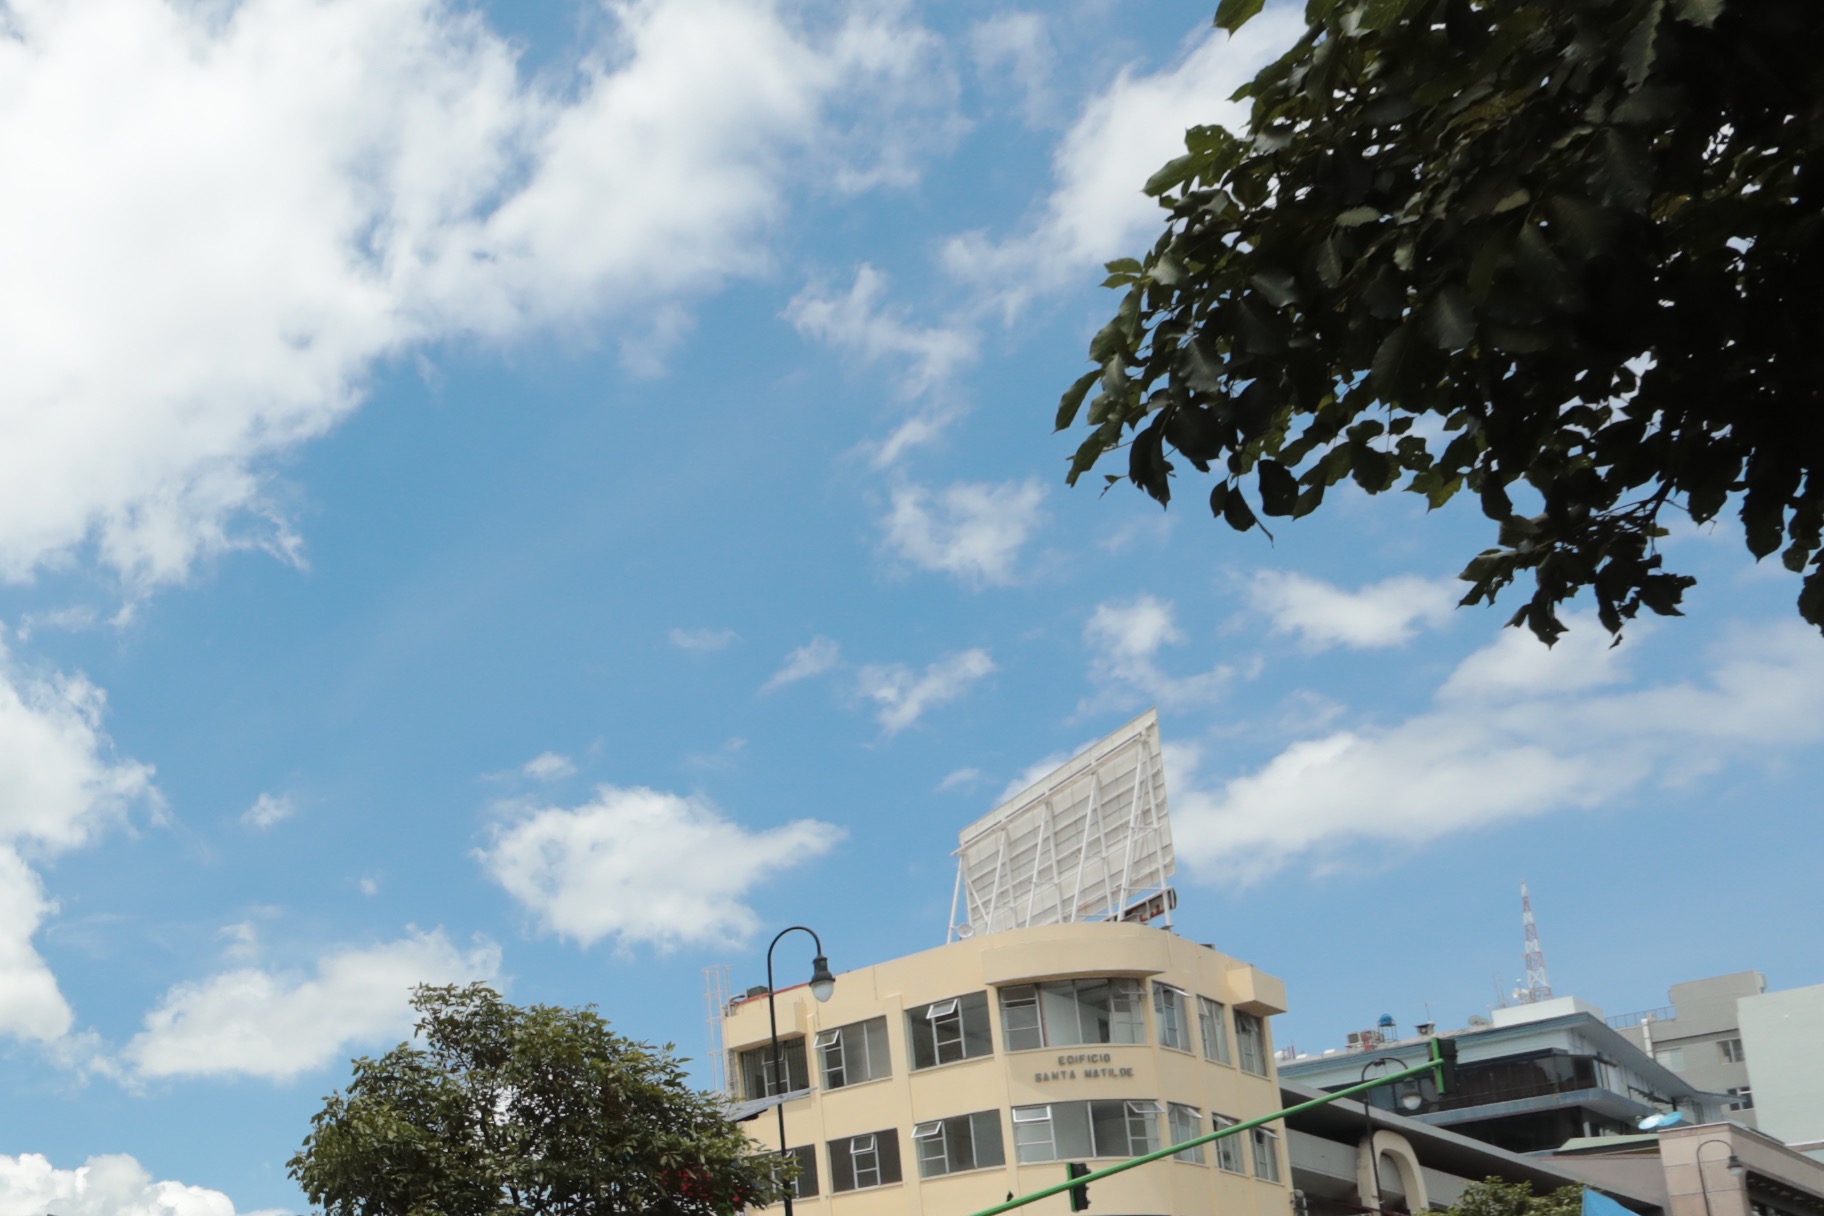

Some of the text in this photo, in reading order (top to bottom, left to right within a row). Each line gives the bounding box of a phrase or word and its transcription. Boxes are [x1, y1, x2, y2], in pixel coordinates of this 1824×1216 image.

[1057, 1053, 1111, 1066] EDIFICIO
[1034, 1067, 1134, 1082] SANTA MATILDE
